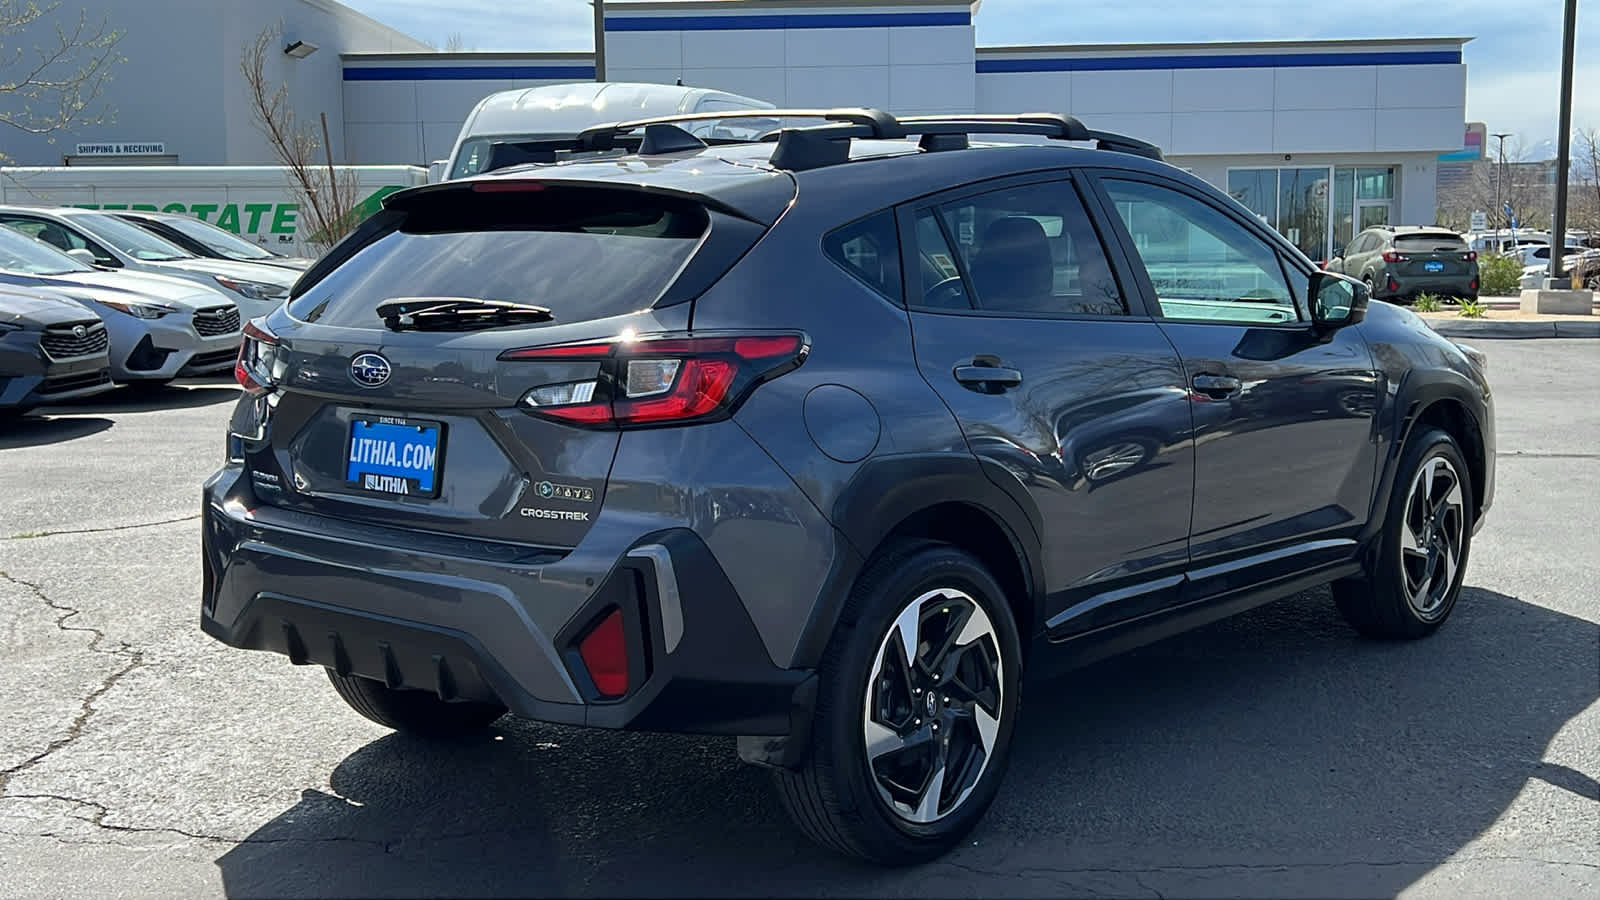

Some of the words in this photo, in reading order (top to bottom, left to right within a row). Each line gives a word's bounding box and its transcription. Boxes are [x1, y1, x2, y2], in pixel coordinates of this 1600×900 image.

[79, 144, 114, 154] SHIPPING
[115, 144, 121, 153] &
[123, 143, 163, 153] RECEIVING
[349, 437, 436, 471] LITHIA.COM
[375, 474, 408, 495] LITHIA
[520, 507, 589, 521] CROSSTREK
